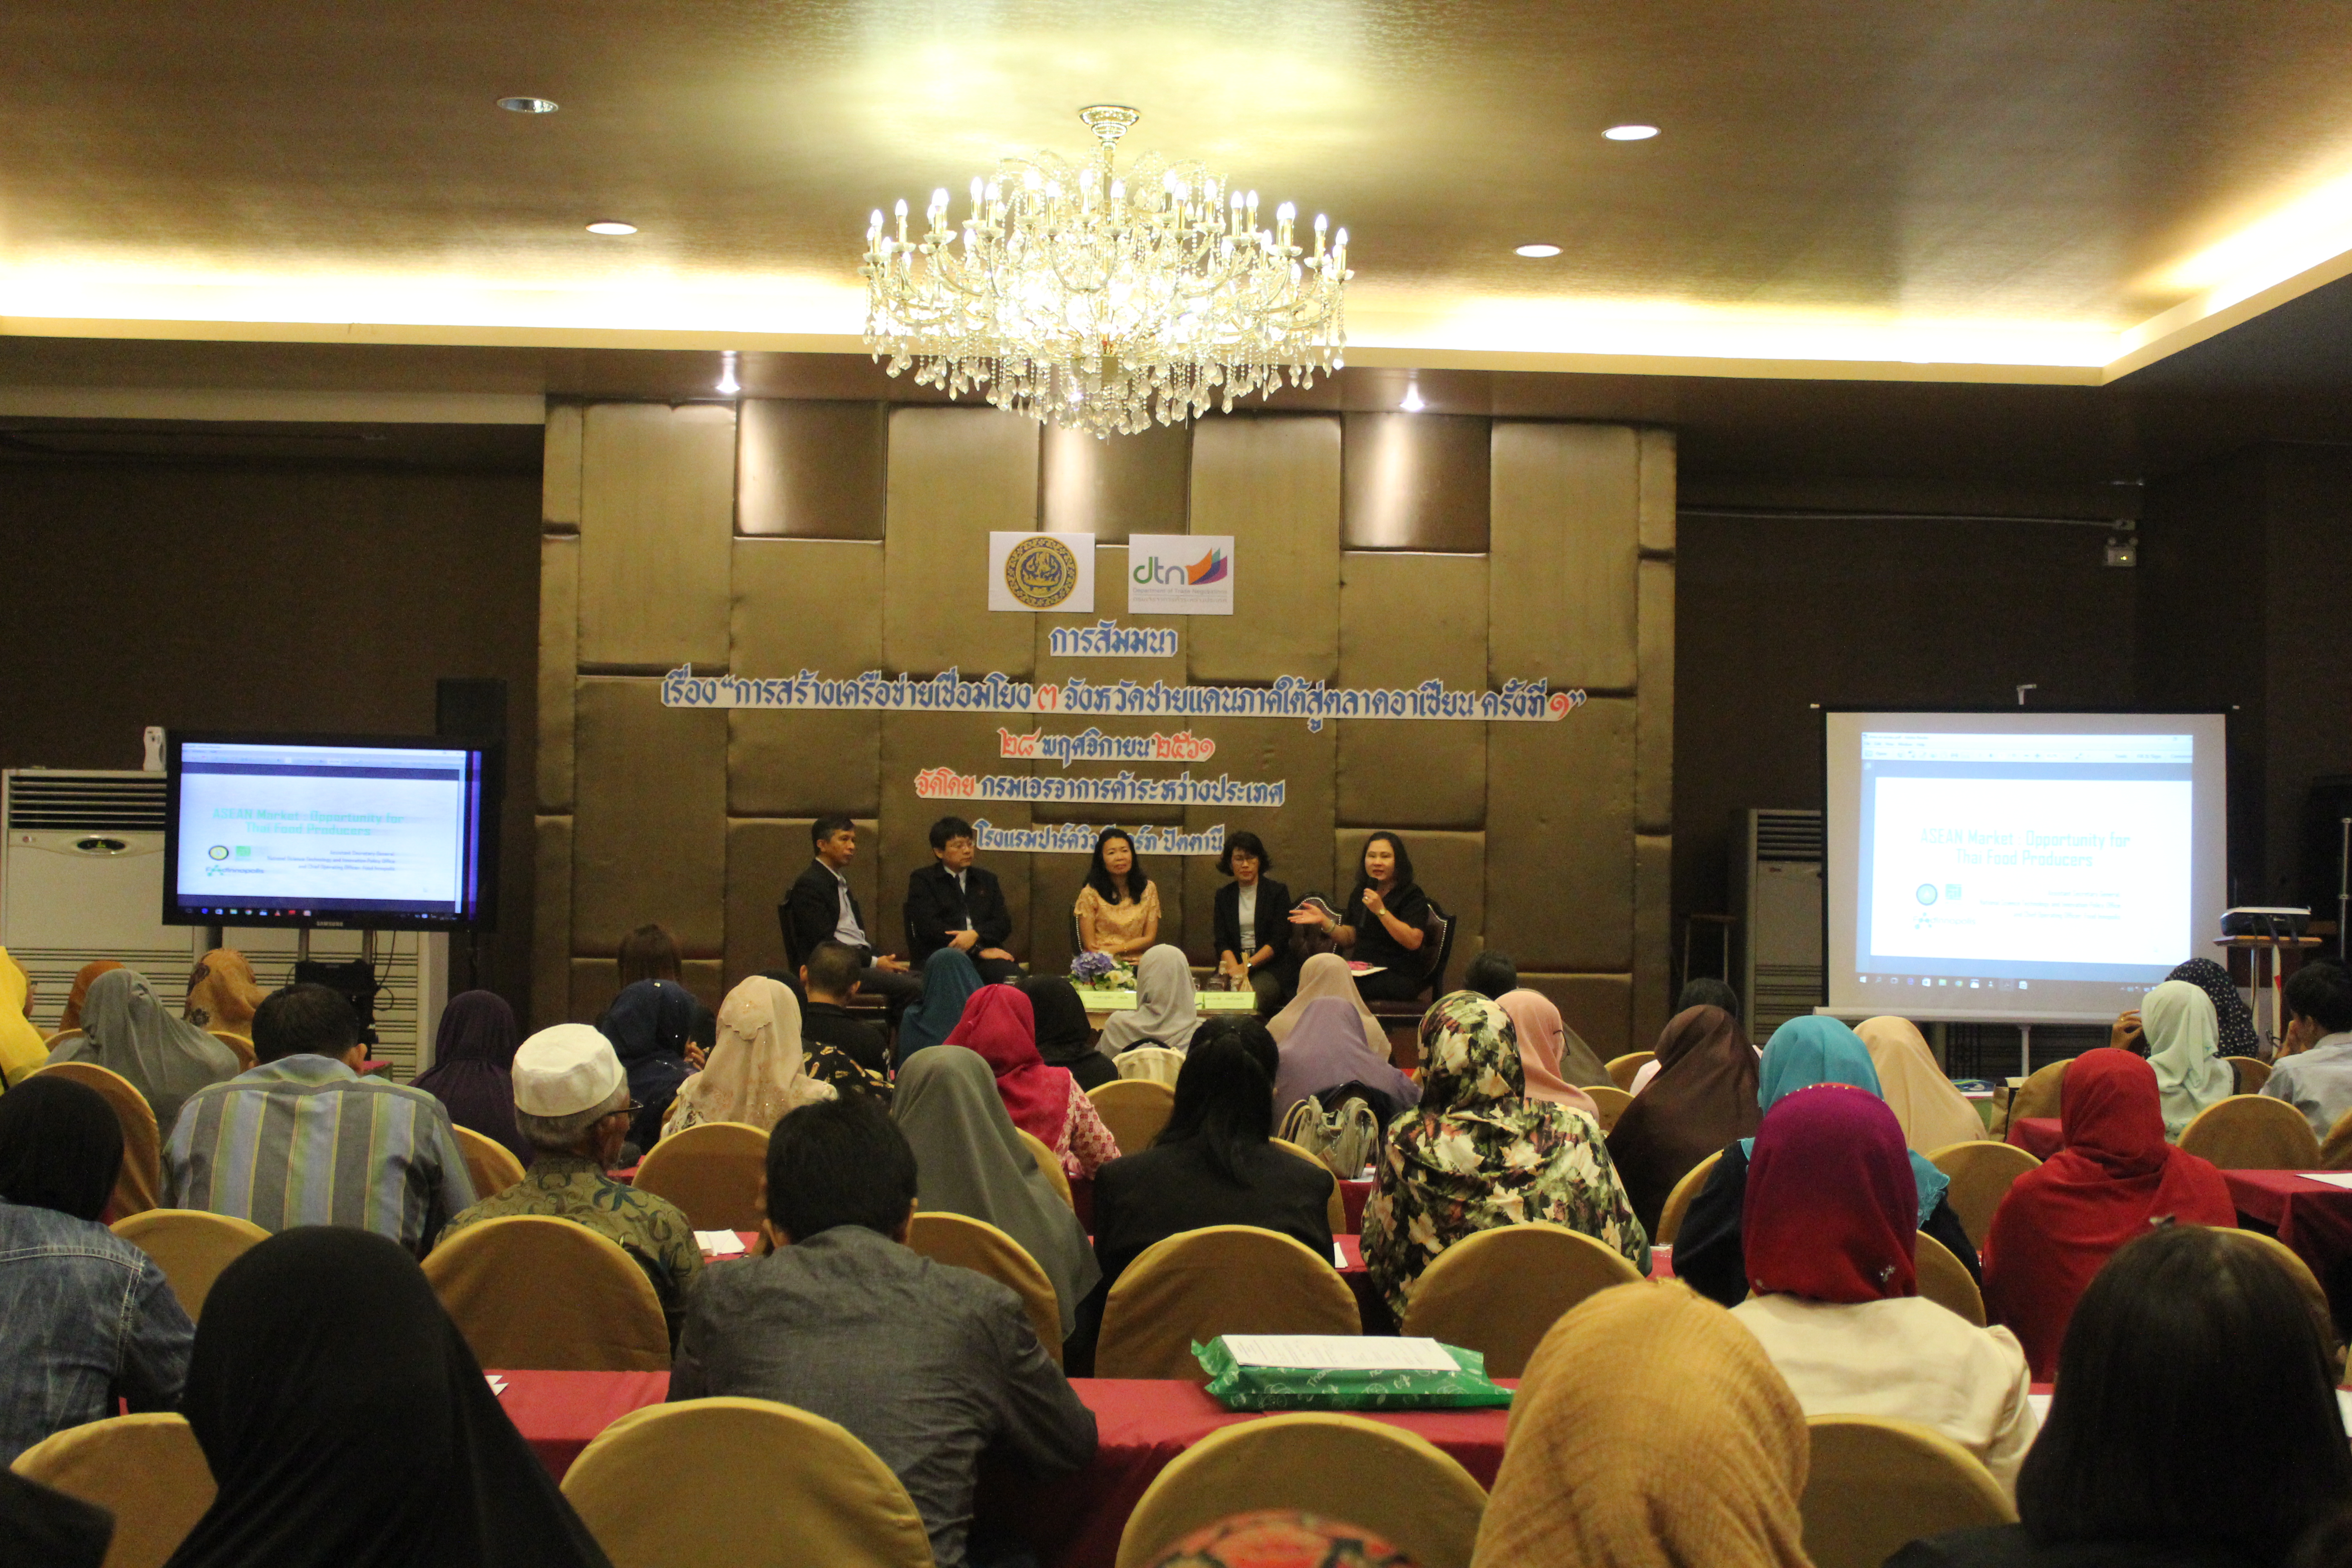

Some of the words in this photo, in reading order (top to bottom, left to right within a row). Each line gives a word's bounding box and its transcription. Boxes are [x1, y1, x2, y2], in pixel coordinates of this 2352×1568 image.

[1133, 556, 1185, 584] dtn
[1050, 621, 1176, 655] การสัมมนา
[916, 767, 975, 797] จัดโดย
[981, 771, 1283, 804] กรมเจรจาการค้าระหว่างประเทศ
[213, 808, 252, 819] ASEAN
[257, 809, 299, 820] Market
[310, 810, 382, 825] Opportunity
[386, 812, 403, 823] for
[246, 822, 270, 833] Thai
[274, 823, 302, 834] Food
[307, 823, 371, 835] Producers
[1920, 828, 1963, 844] ASEAN
[1968, 829, 2014, 845] Market
[2026, 830, 2105, 850] Opportunity
[2110, 831, 2131, 848] for
[1956, 848, 1982, 864] Thai
[1987, 849, 2017, 865] Food
[2022, 849, 2093, 867] Producers
